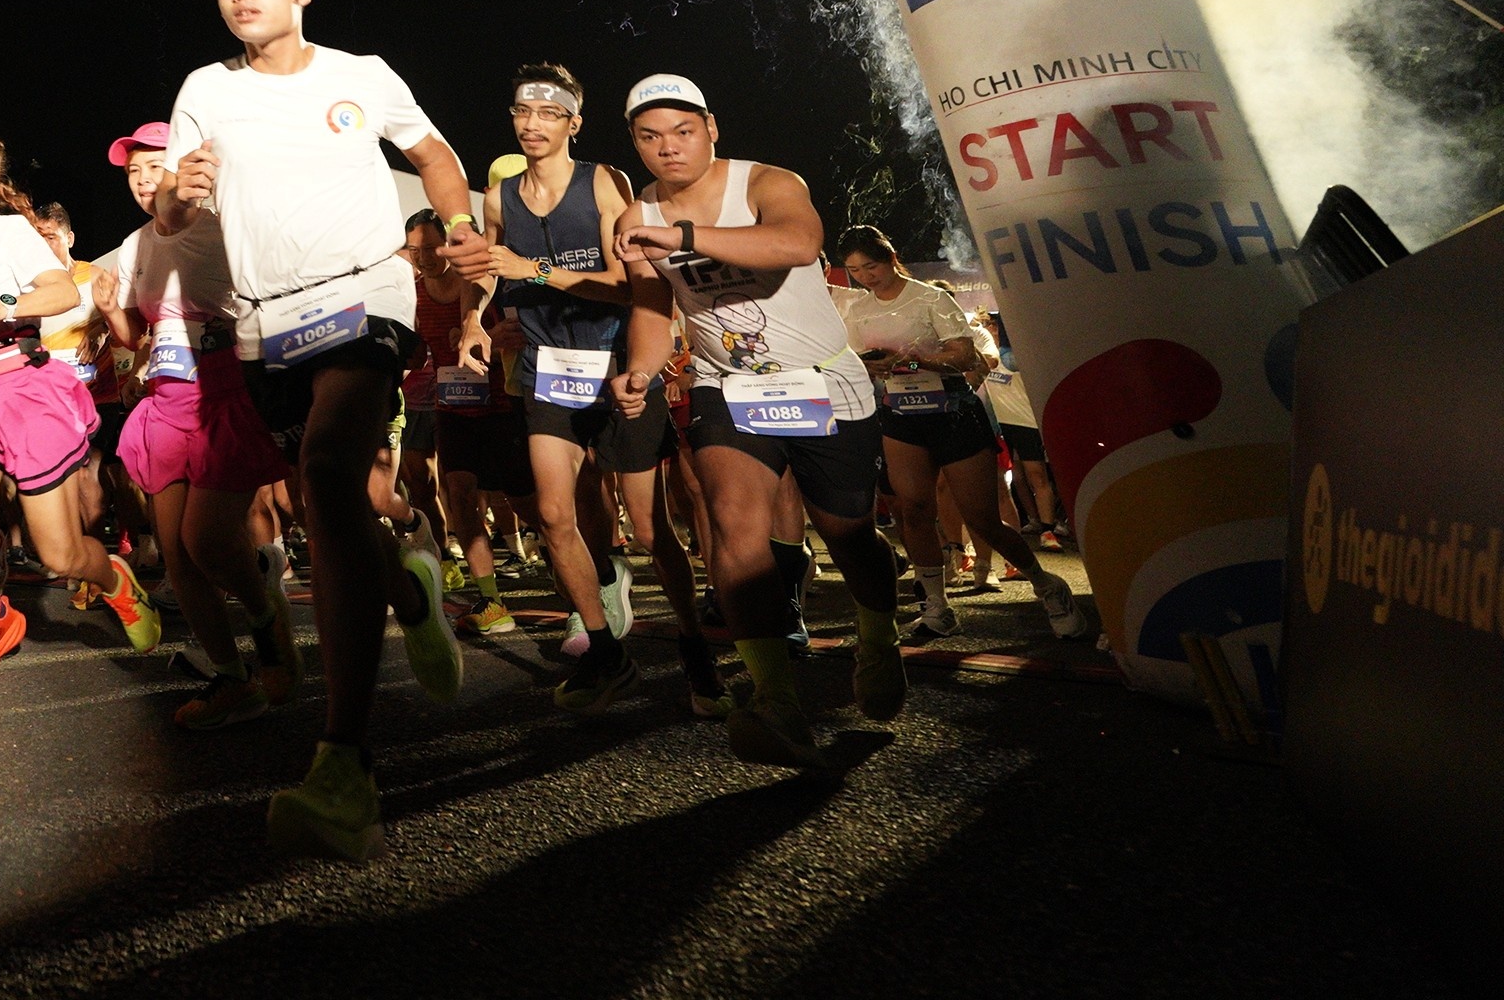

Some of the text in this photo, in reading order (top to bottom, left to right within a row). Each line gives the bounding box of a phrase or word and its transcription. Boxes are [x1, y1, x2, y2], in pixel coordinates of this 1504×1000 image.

[938, 38, 1203, 113] HO CHI MINH CITY
[639, 84, 682, 100] HOKA
[959, 100, 1225, 193] START
[982, 200, 1284, 291] FINISH
[293, 319, 337, 346] 1005
[450, 386, 474, 395] 1075
[561, 379, 594, 396] 1280
[903, 395, 929, 405] 1321
[758, 405, 803, 420] 1088
